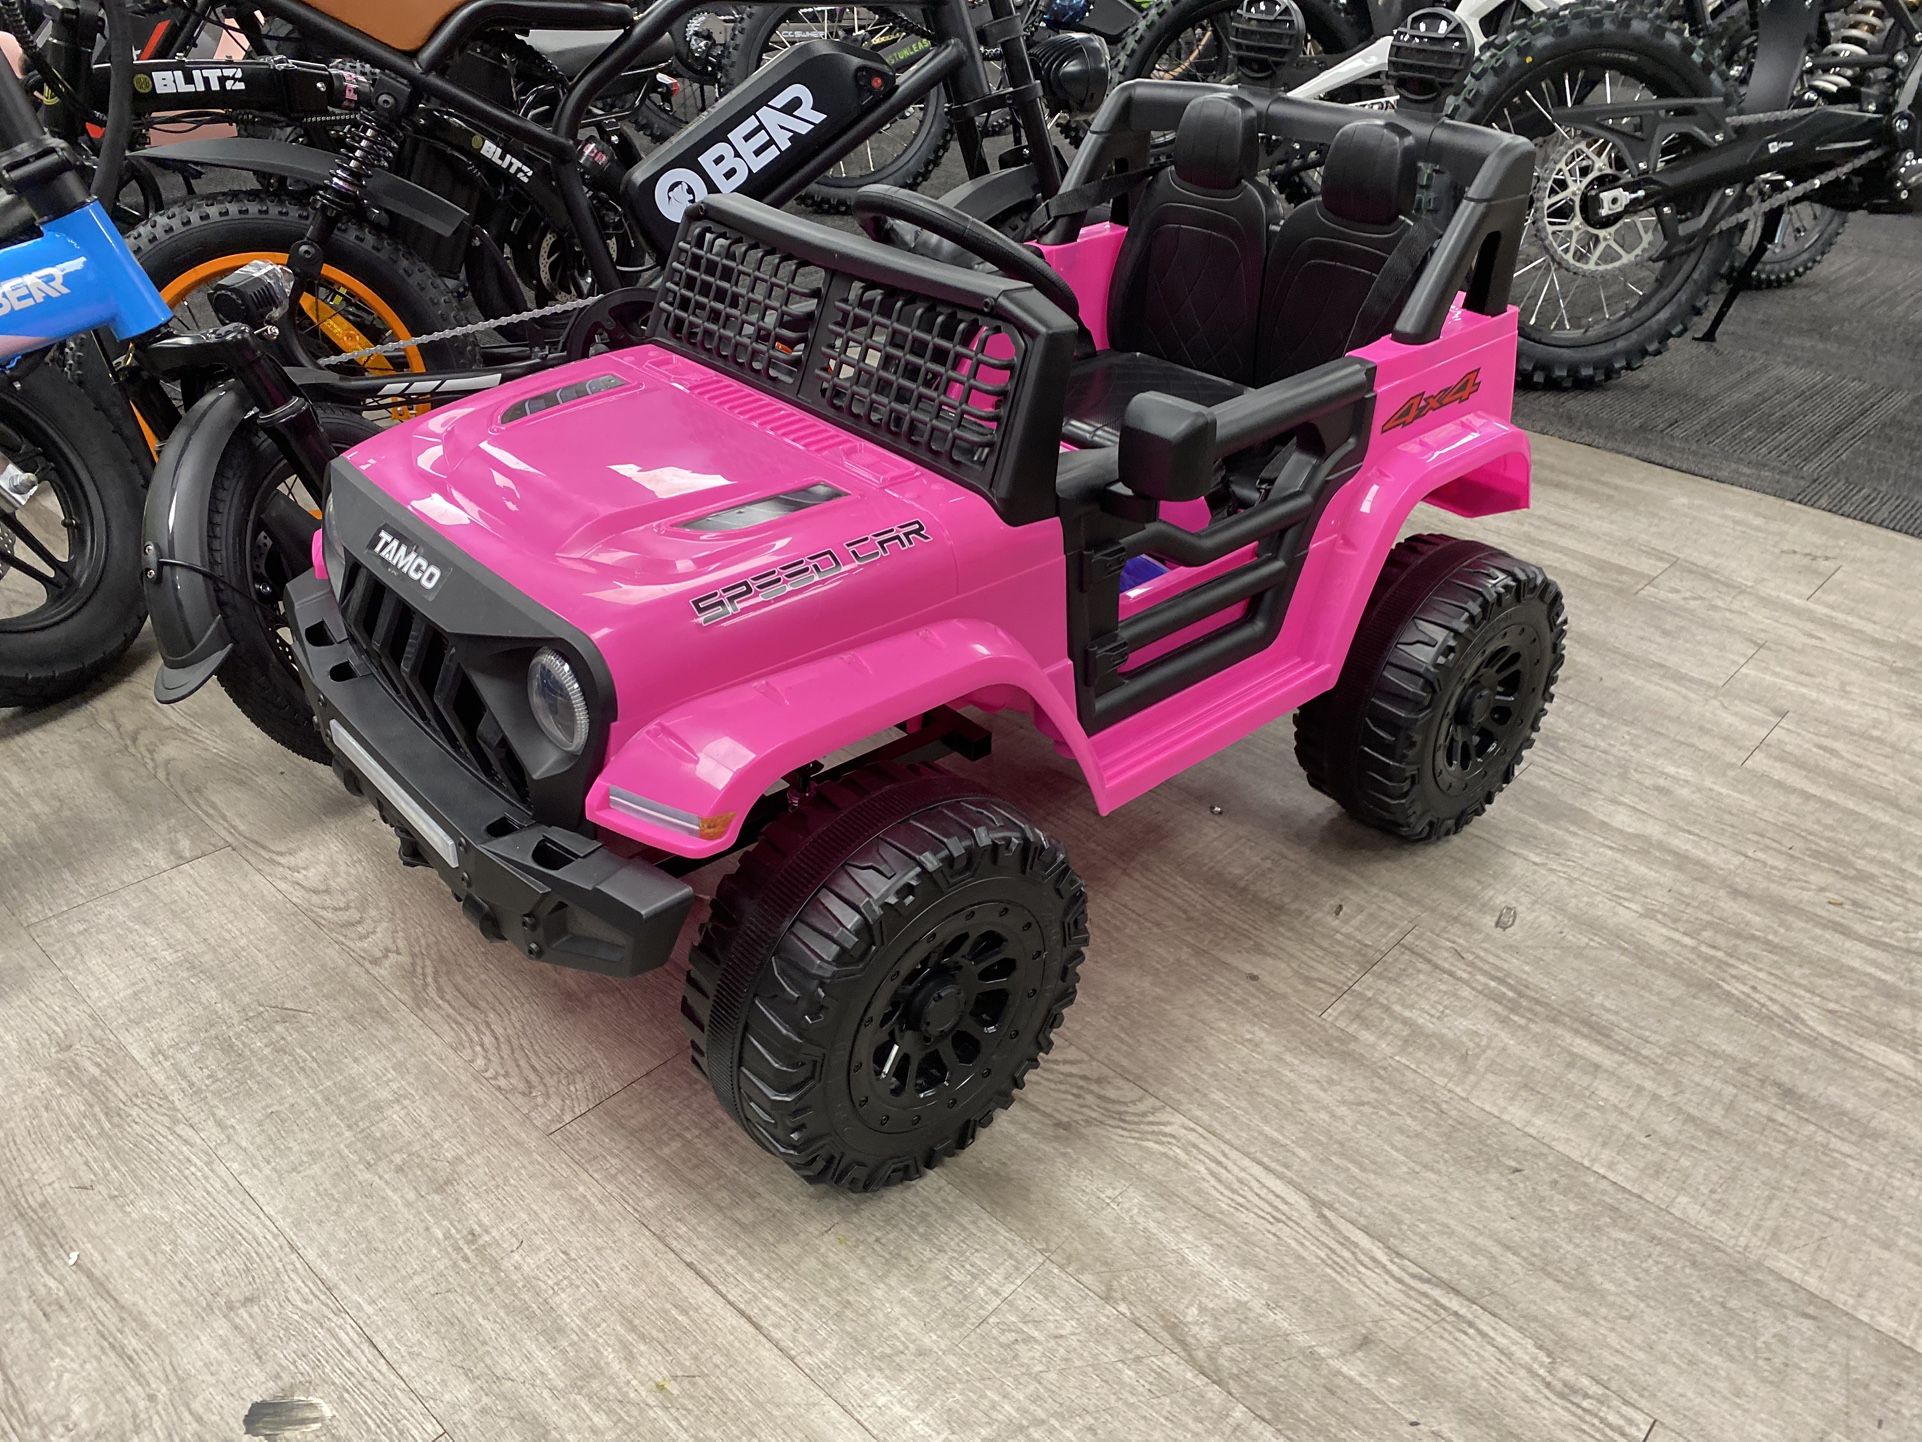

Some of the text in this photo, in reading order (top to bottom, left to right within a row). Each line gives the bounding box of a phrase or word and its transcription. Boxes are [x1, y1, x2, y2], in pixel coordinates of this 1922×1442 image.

[152, 68, 245, 94] BLITZ
[480, 139, 533, 183] BLITZ
[697, 83, 828, 194] BEAR
[374, 529, 441, 590] TAMCO
[690, 518, 933, 626] SPEED CAR
